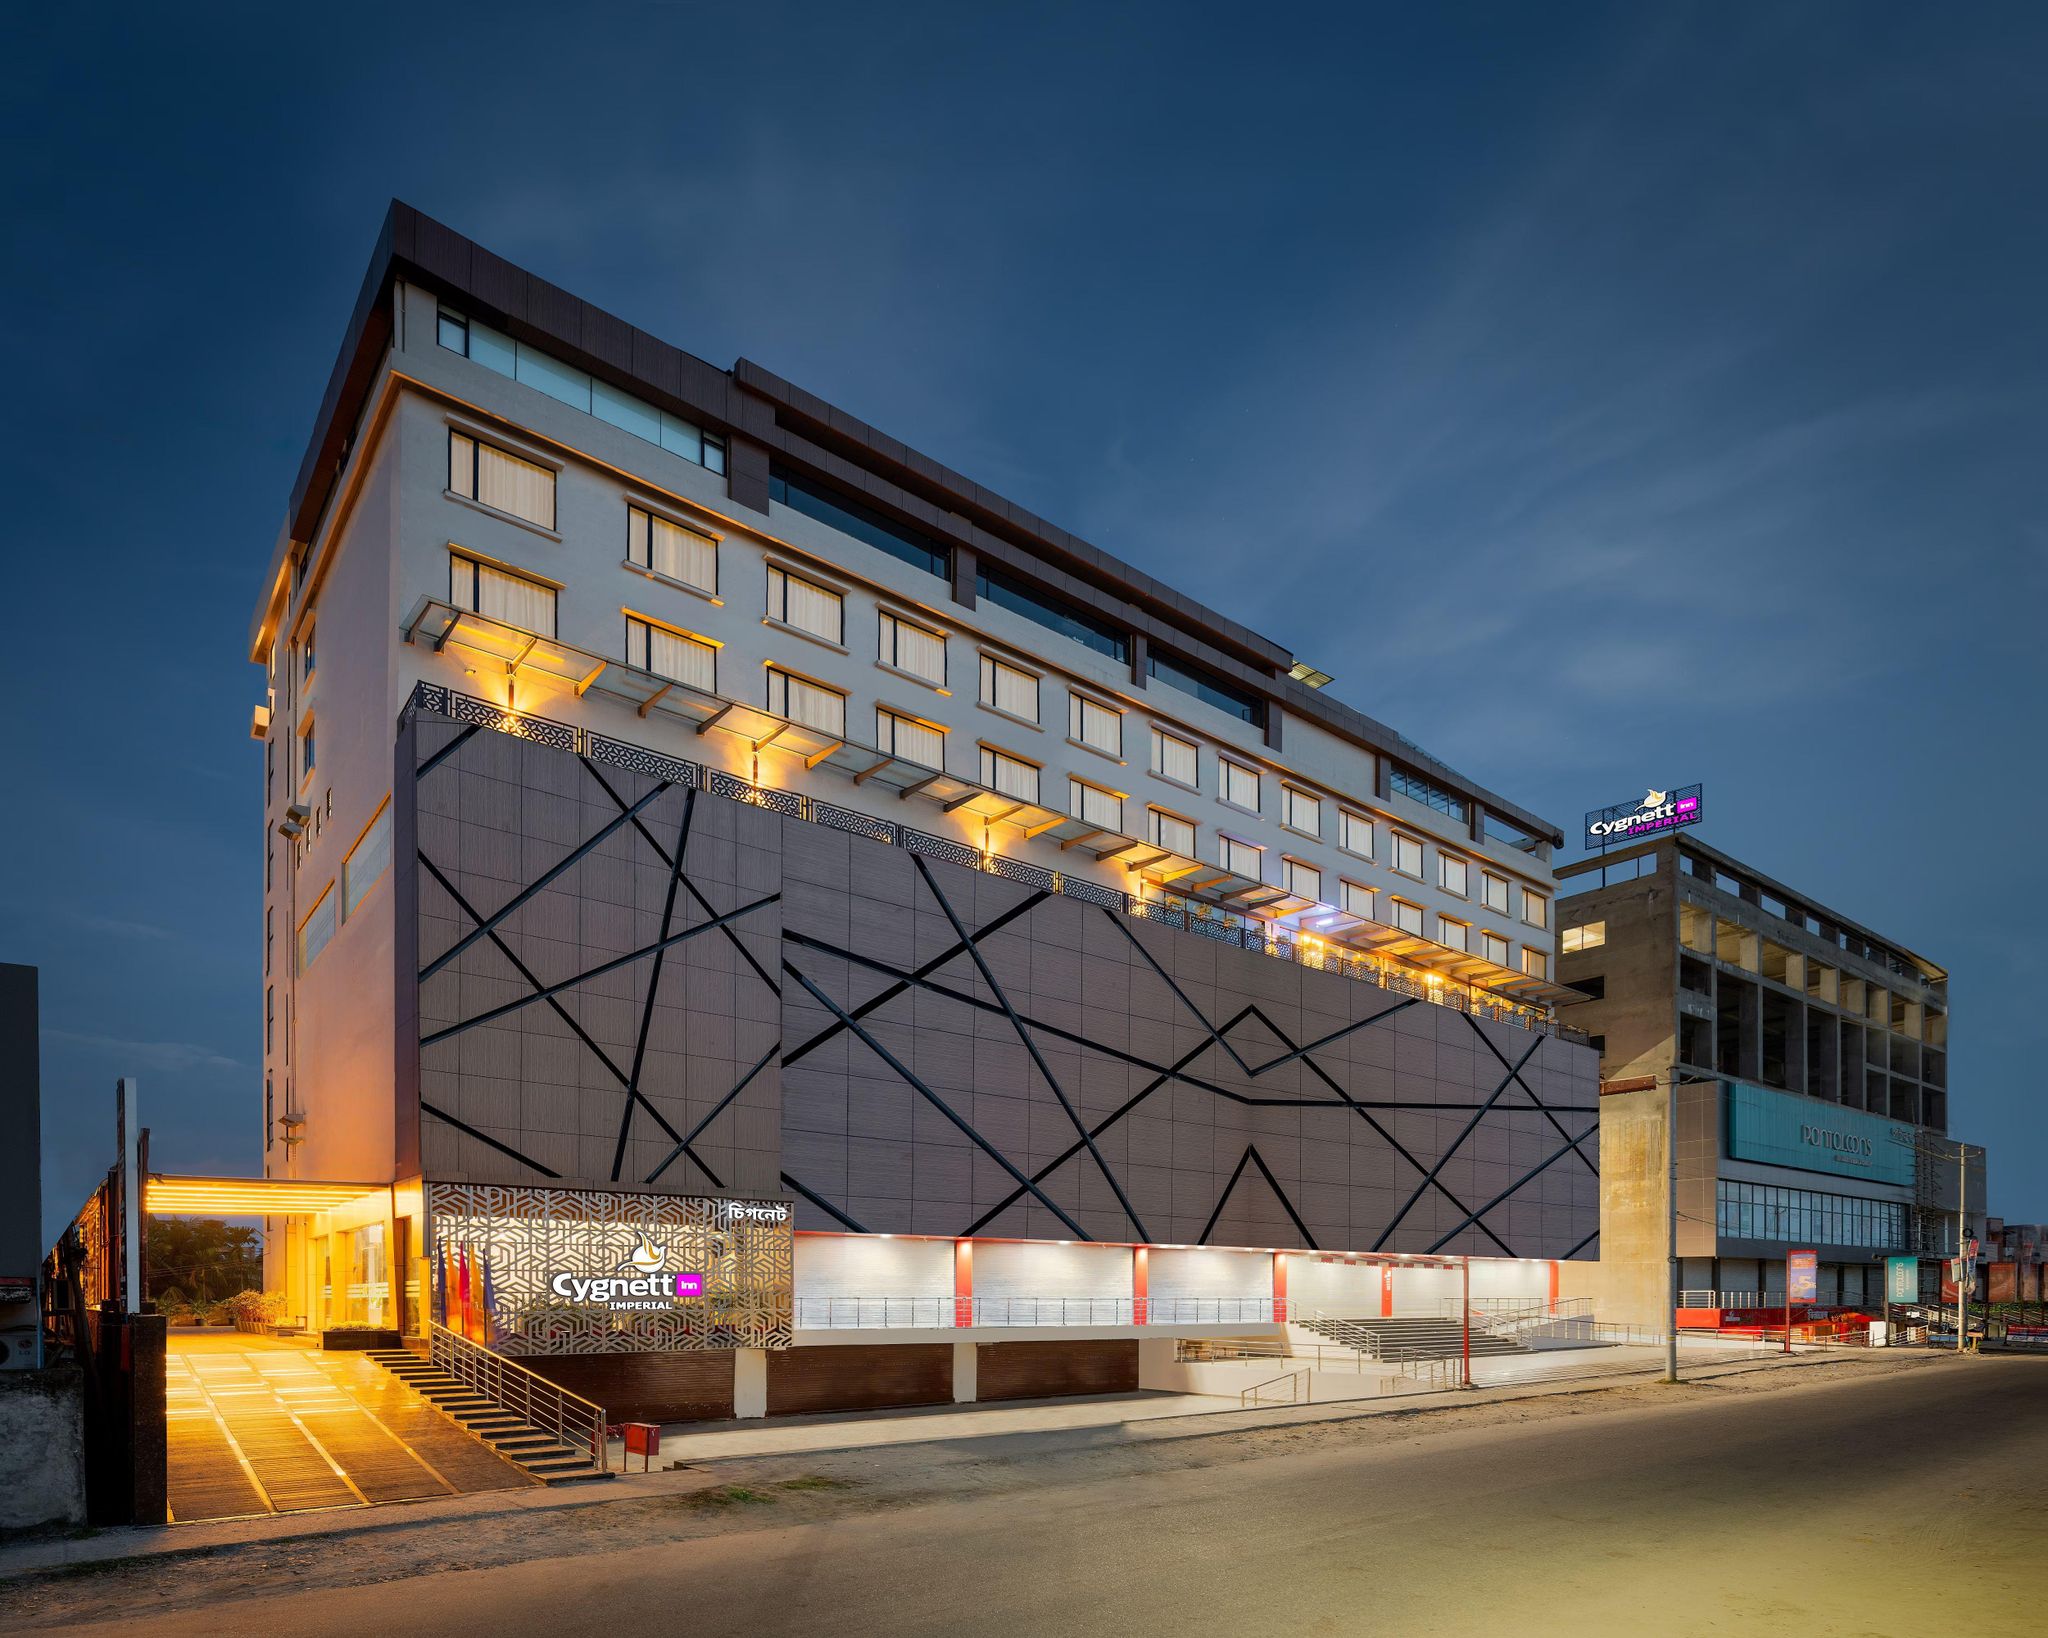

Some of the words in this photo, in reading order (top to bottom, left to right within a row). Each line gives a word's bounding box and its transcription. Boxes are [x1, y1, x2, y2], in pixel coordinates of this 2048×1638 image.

[1590, 803, 1676, 836] Cygnett
[1627, 812, 1697, 835] IMPERIAL
[552, 1272, 675, 1303] Cygnett
[681, 1280, 698, 1290] Inn
[609, 1301, 673, 1311] IMPERIAL
